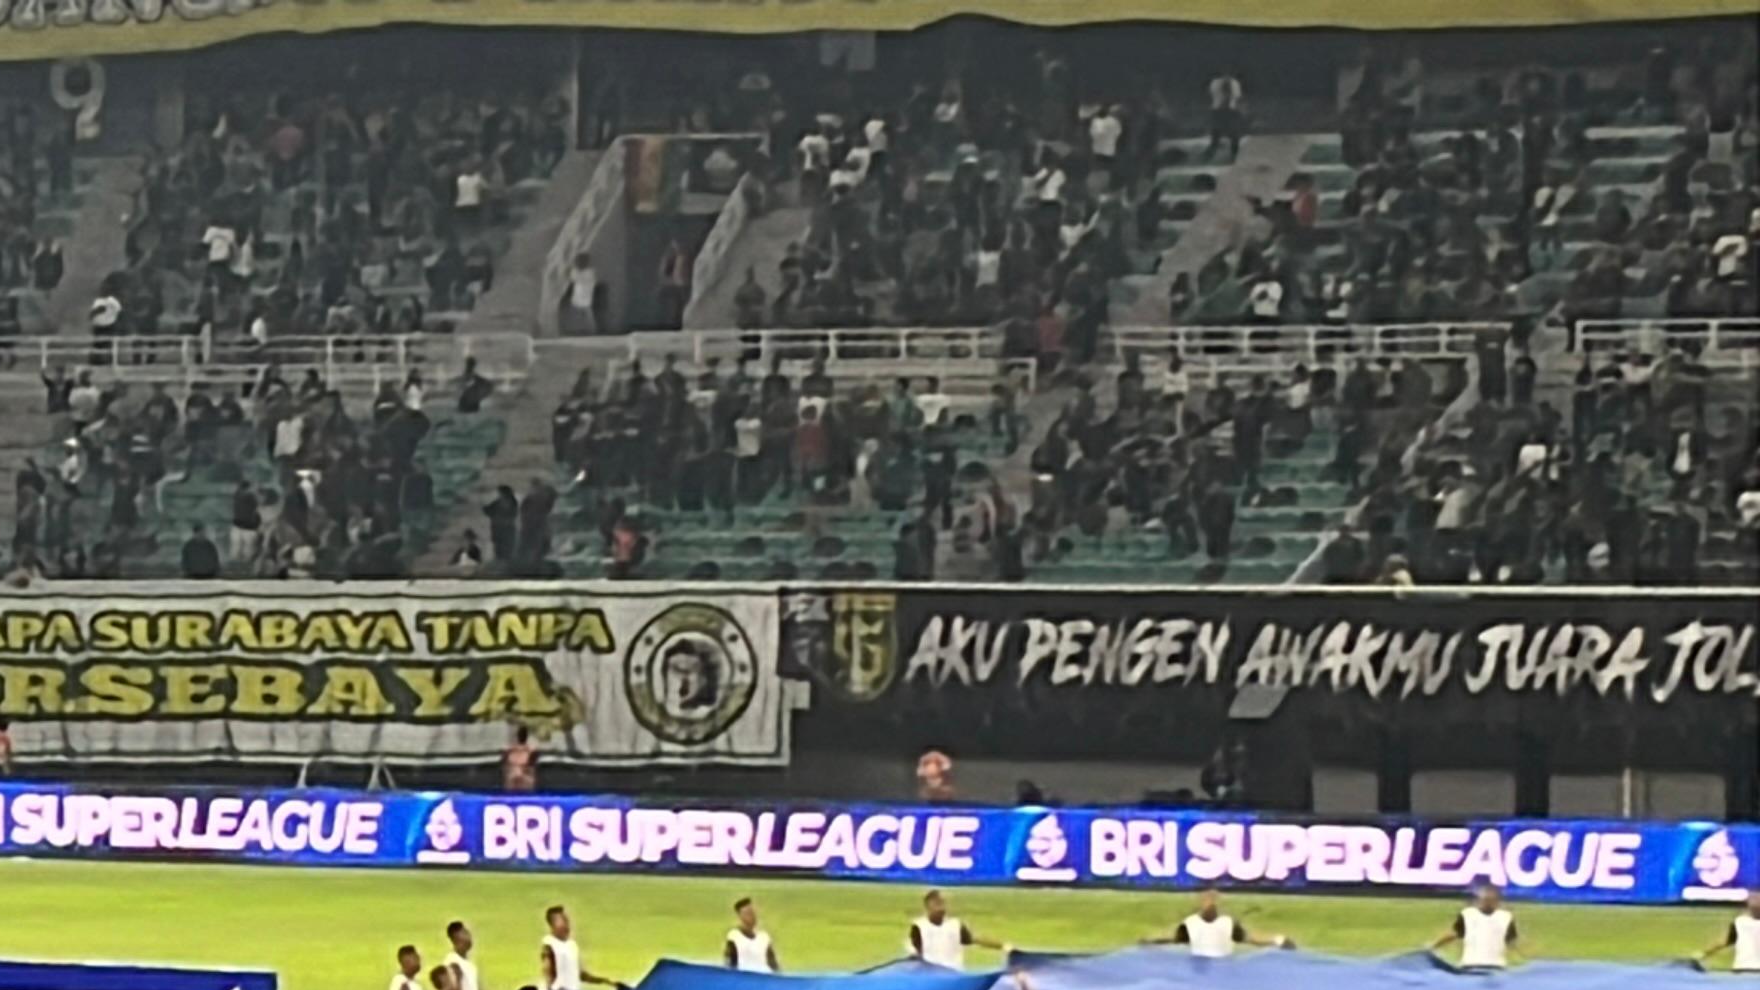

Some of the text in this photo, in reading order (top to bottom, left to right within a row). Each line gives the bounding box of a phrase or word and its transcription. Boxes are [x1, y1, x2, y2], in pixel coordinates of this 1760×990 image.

[90, 609, 411, 652] SURABAYA
[418, 607, 615, 654] TANPA
[903, 614, 1760, 704] AKU PENGEN AWAKMU JUARA JOL
[483, 804, 563, 861] BRI
[1089, 818, 1178, 878] BRI
